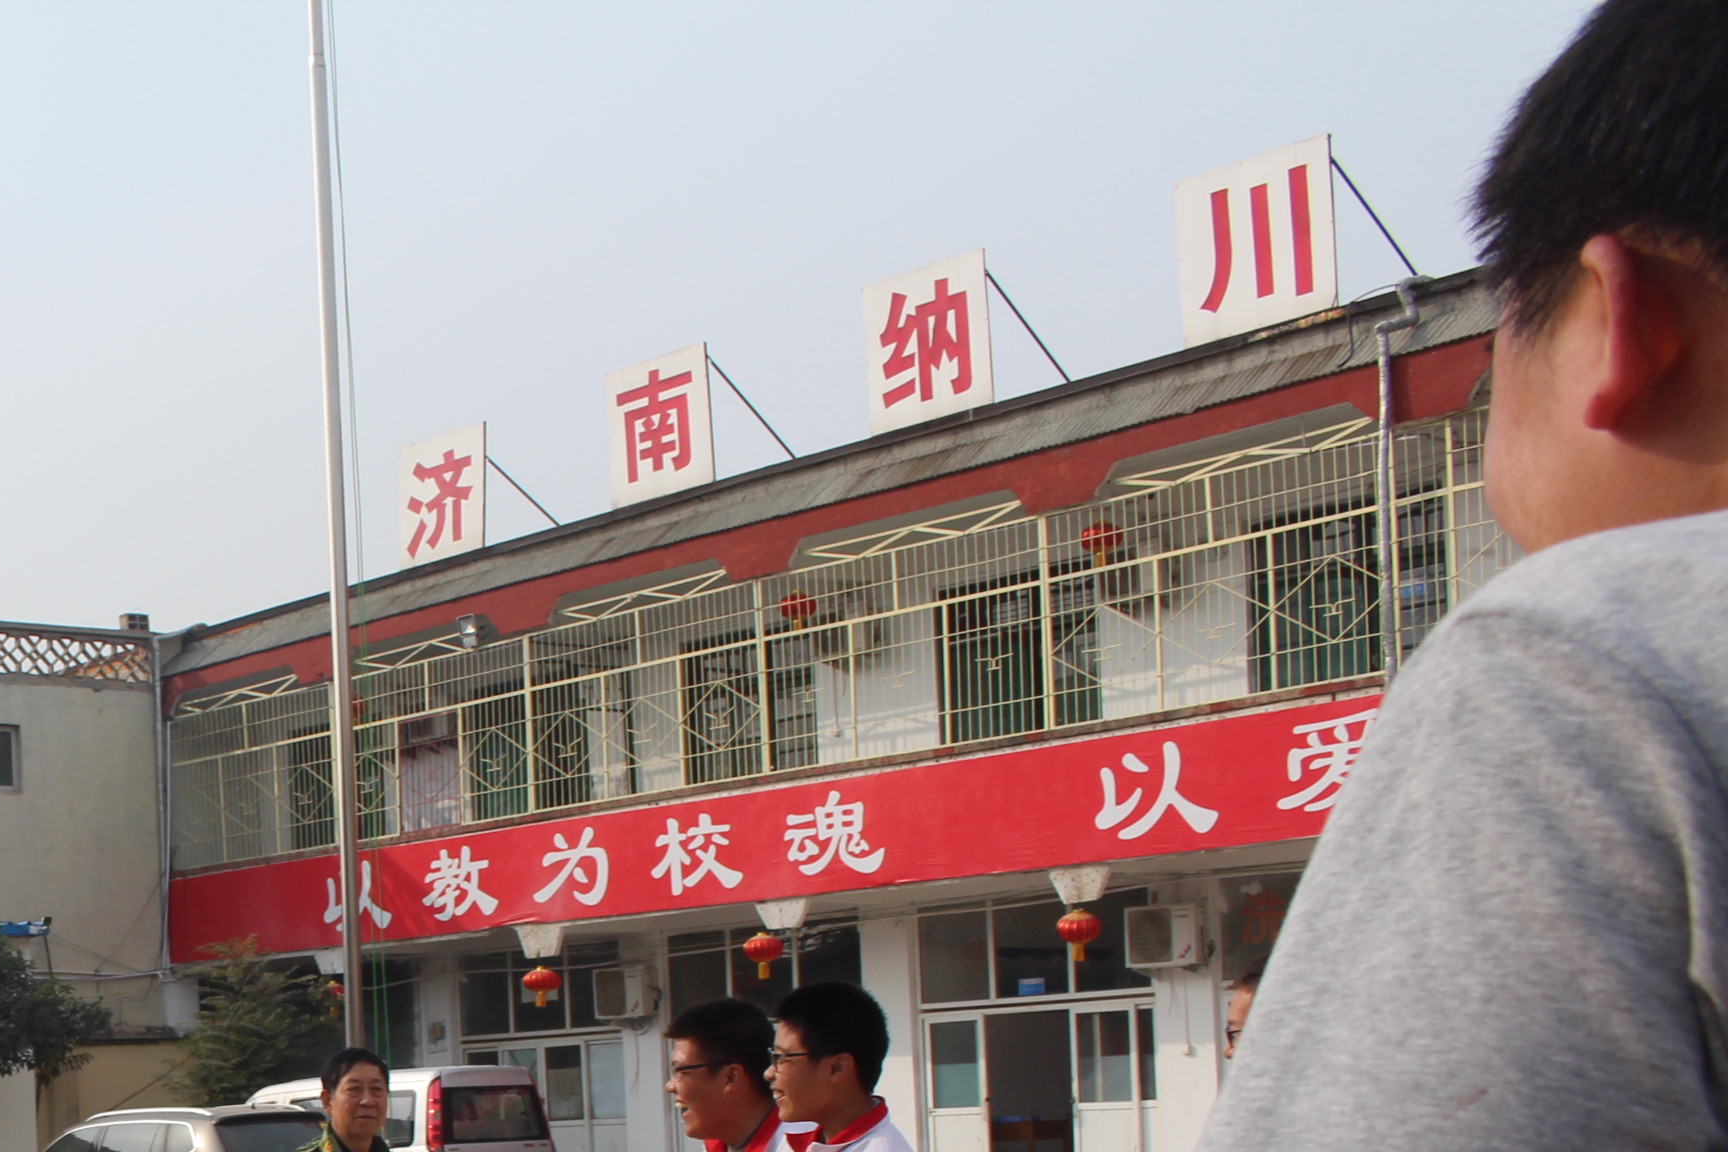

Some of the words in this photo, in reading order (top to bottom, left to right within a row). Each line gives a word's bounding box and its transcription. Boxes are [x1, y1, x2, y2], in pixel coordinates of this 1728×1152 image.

[323, 790, 885, 930] 以教为校魂
